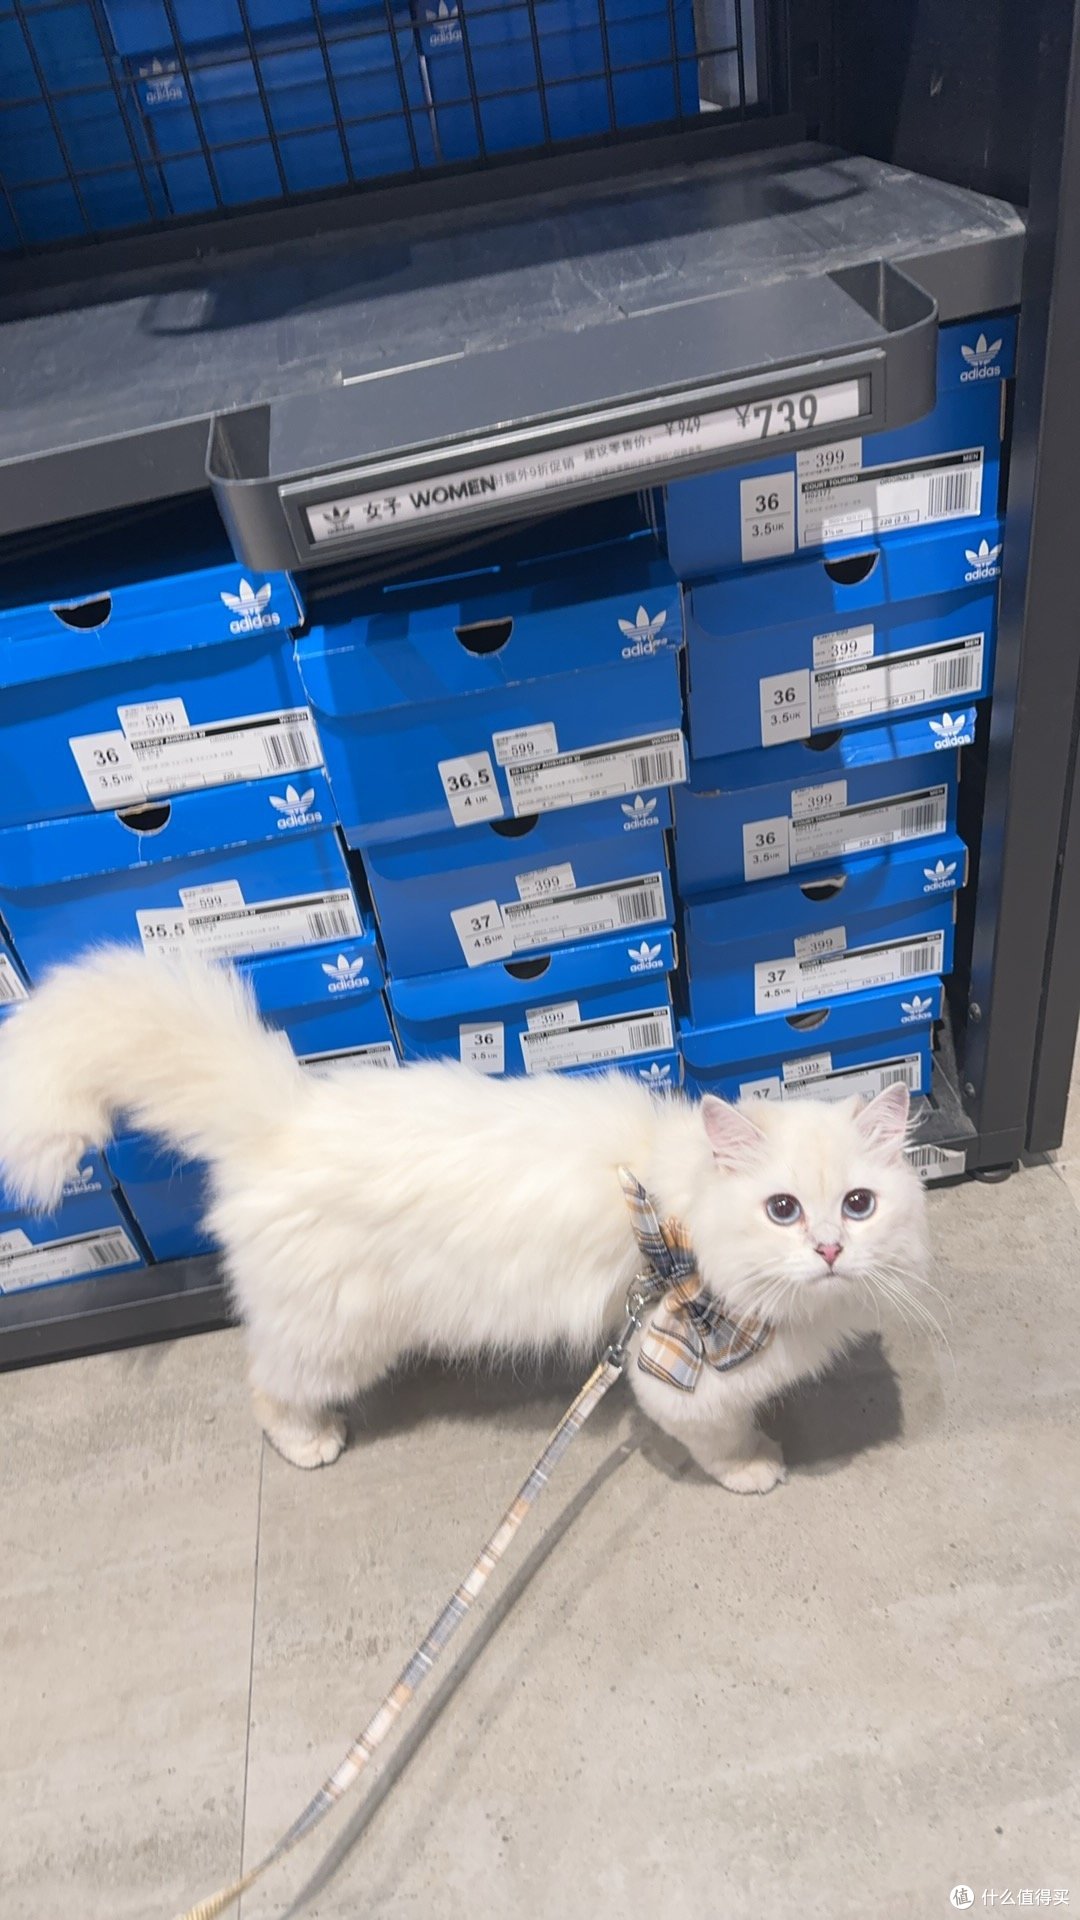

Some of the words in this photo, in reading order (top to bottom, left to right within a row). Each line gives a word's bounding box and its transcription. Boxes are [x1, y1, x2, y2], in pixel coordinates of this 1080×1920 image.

[960, 366, 1001, 382] adidas
[816, 450, 844, 468] 399
[963, 453, 979, 462] MEN
[496, 456, 575, 488] 额外9折促销
[805, 480, 827, 491] COURT
[364, 497, 401, 522] 女子
[409, 475, 496, 509] WOMEN
[755, 493, 779, 513] 36
[964, 566, 1001, 583] adidas
[230, 612, 280, 634] adidas
[831, 640, 858, 657] 399
[965, 638, 981, 647] MEN
[774, 687, 796, 705] 36
[145, 711, 175, 729] 599
[511, 742, 535, 757] 599
[934, 734, 971, 750] adidas
[94, 748, 119, 766] 36
[448, 768, 490, 792] 36.5
[464, 796, 473, 806] 4
[476, 795, 489, 804] UK
[807, 792, 832, 809] 399
[277, 811, 322, 830] adidas
[623, 816, 660, 832] adidas
[755, 832, 775, 848] 36
[535, 876, 560, 892] 399
[923, 878, 956, 893] adidas
[199, 895, 222, 909] 599
[144, 923, 185, 939] 35.5
[470, 915, 491, 931] 37
[809, 938, 833, 953] 399
[630, 958, 664, 973] adidas
[328, 976, 370, 993] adidas
[767, 970, 787, 984] 37
[541, 1012, 565, 1025] 399
[901, 1011, 932, 1024] adidas
[474, 1033, 494, 1045] 36
[798, 1062, 820, 1075] 399
[753, 1087, 770, 1100] 37
